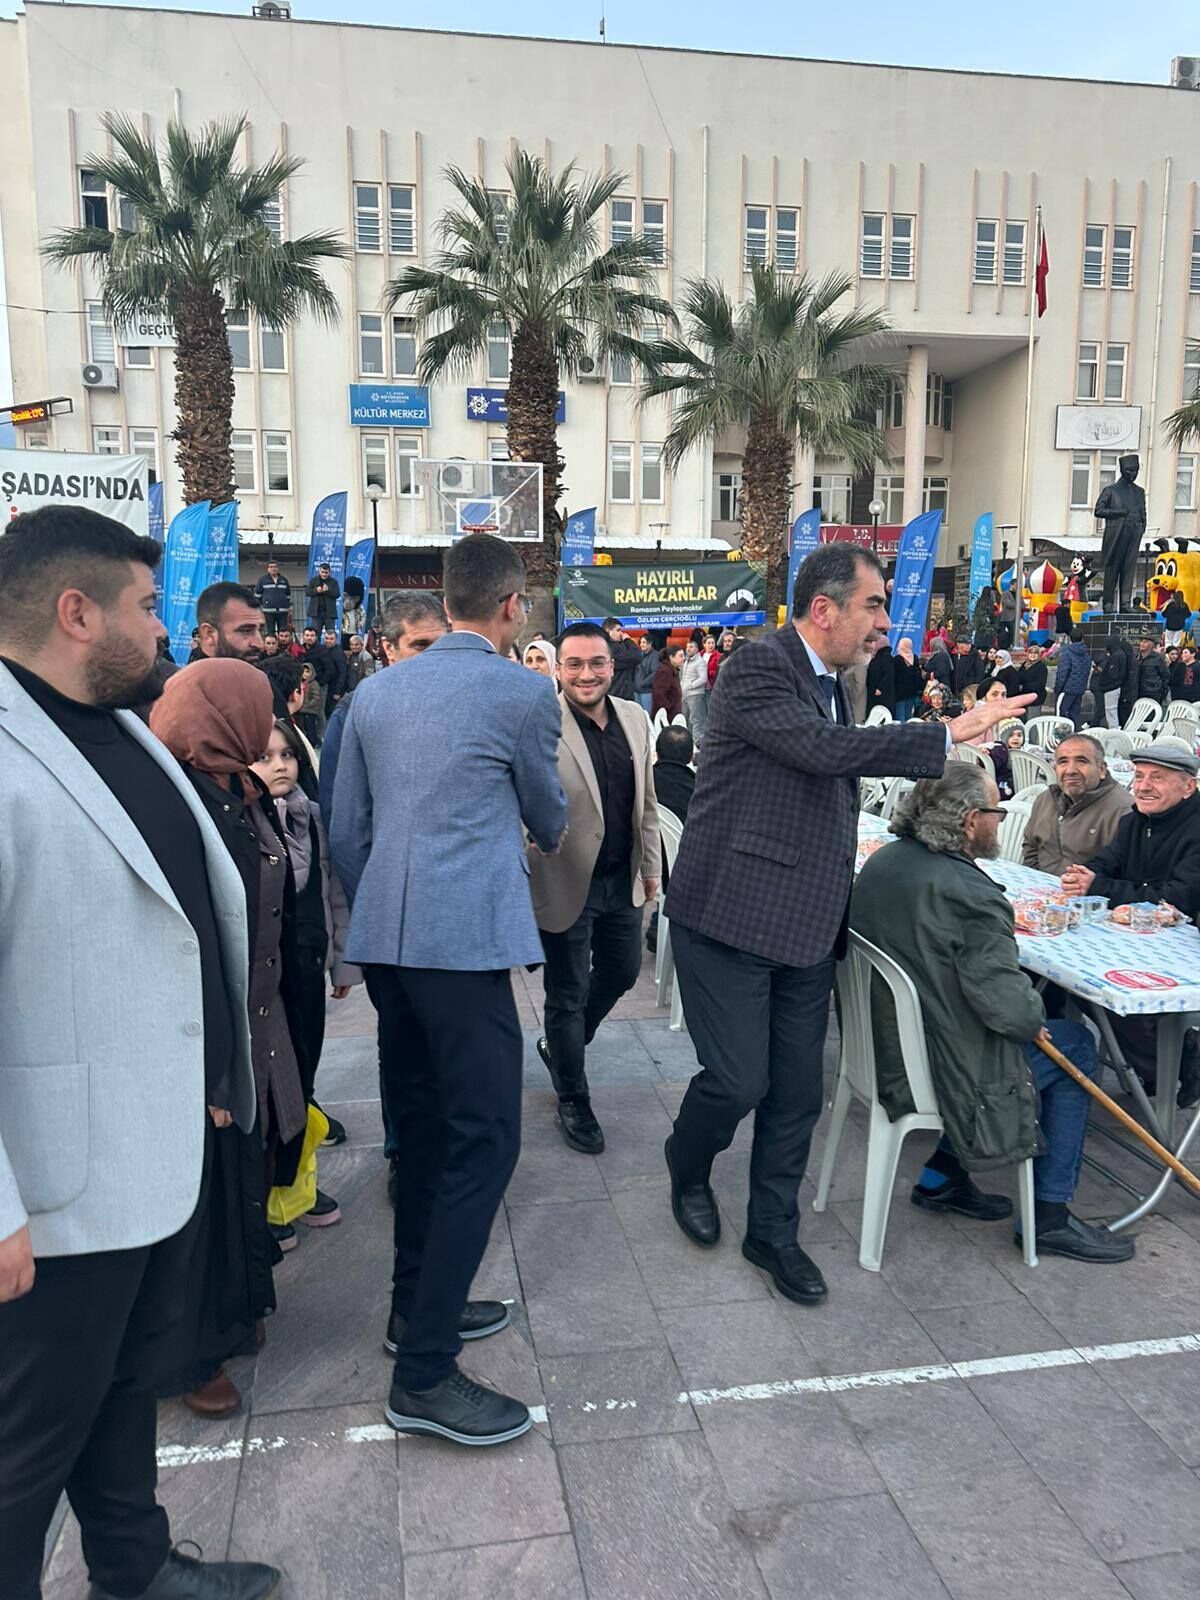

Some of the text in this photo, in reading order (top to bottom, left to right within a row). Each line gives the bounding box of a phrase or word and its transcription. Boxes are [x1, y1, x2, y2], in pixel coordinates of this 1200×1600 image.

[354, 406, 427, 420] KÜLTÜR MERKEZİ
[1, 471, 145, 502] ŞADASI'NDA
[637, 569, 695, 587] HAYIRLI
[614, 585, 718, 604] RAMAZANLAR
